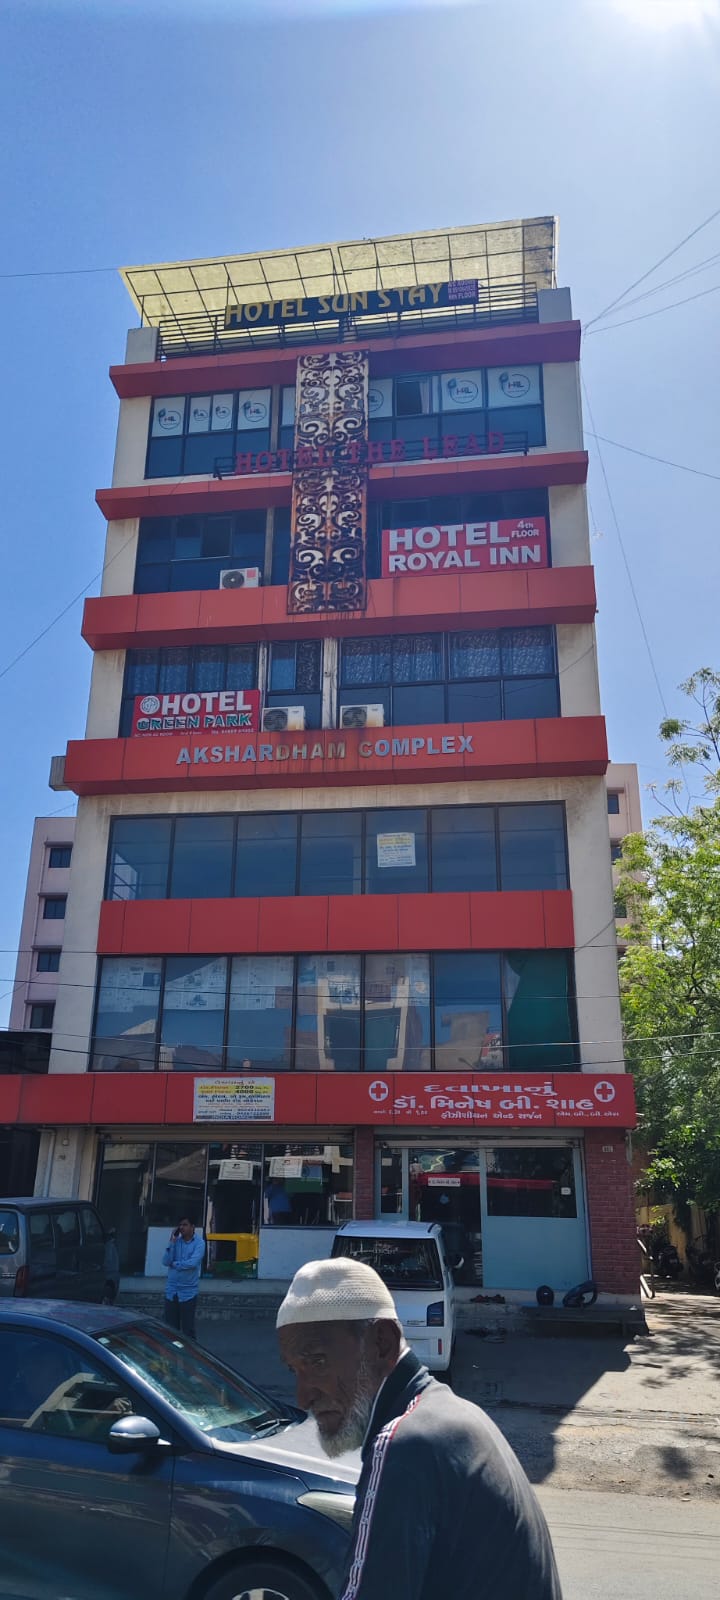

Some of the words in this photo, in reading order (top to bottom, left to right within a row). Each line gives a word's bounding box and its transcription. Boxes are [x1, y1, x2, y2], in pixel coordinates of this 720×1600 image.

[225, 298, 309, 326] HOTEL
[318, 291, 368, 315] SUN
[377, 282, 443, 309] STAY
[234, 445, 333, 475] HOTEL
[348, 440, 406, 464] THE
[423, 432, 506, 460] LEAD
[388, 521, 510, 552] HOTEL
[511, 528, 539, 538] FLOOR
[388, 550, 480, 572] ROYAL
[489, 545, 541, 565] INN
[161, 690, 252, 716] HOTEL
[136, 715, 201, 731] GREEN
[203, 712, 252, 729] PARK
[175, 742, 346, 765] AKSHARDHAM
[358, 735, 474, 758] COMPLEX
[423, 1081, 558, 1096] દવાખાનું
[430, 1095, 491, 1109] મિનેષ
[499, 1095, 540, 1109] બી.
[546, 1098, 594, 1110] શાહ
